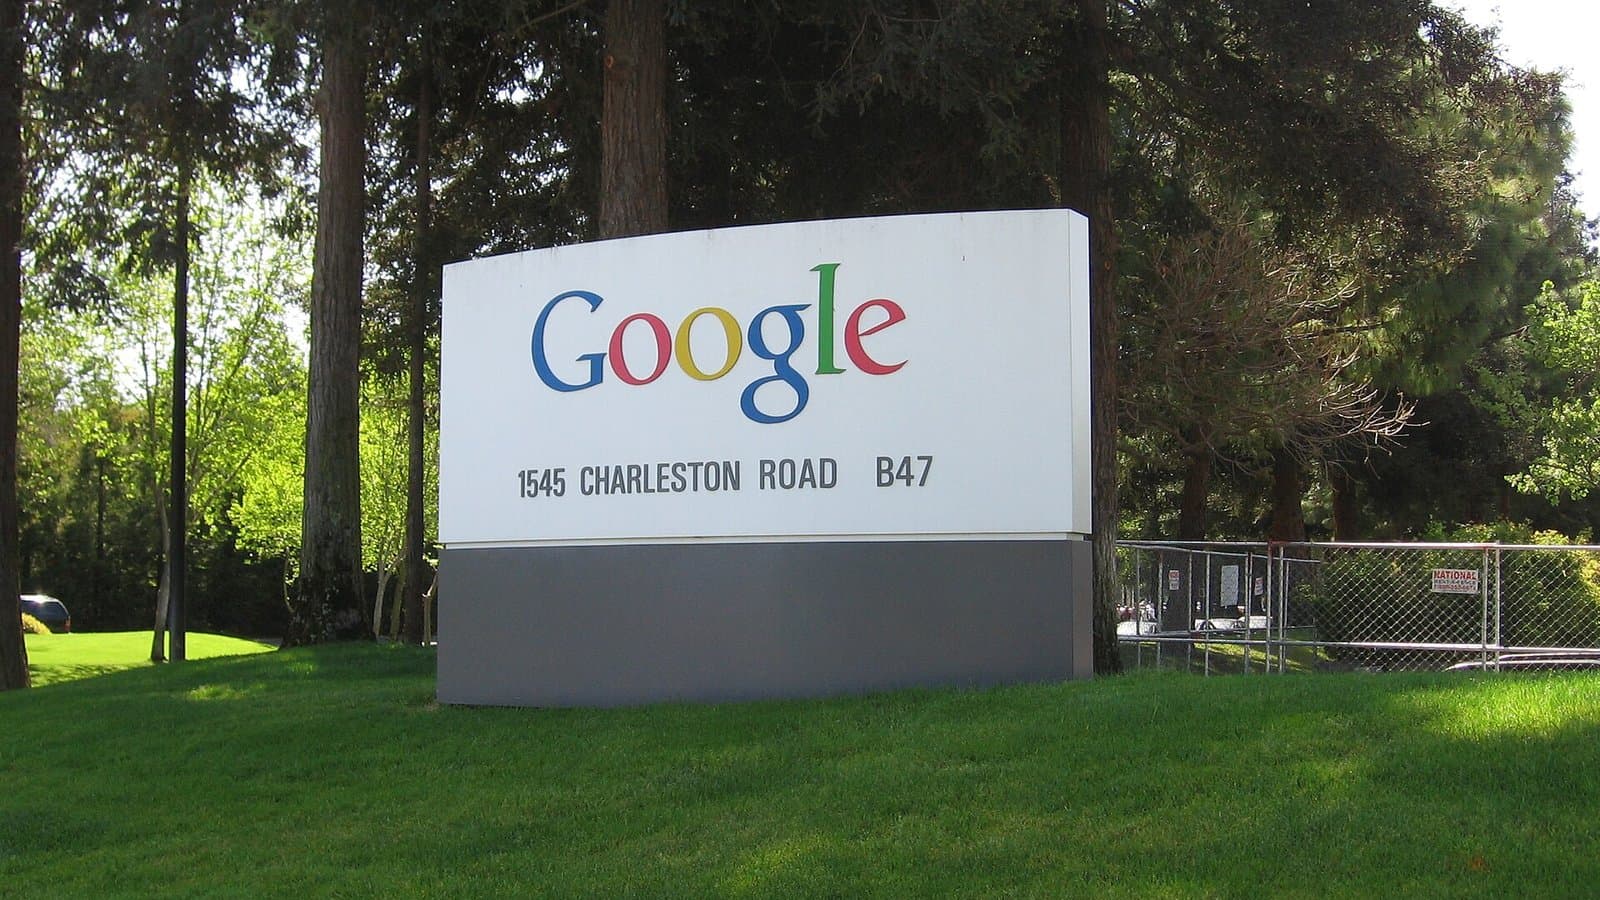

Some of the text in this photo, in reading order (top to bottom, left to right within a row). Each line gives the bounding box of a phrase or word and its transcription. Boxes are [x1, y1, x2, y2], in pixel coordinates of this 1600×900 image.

[531, 263, 908, 424] Google
[518, 455, 934, 498] 1545 CHARLESTON ROAD B47
[1434, 571, 1477, 580] NATIONAL
